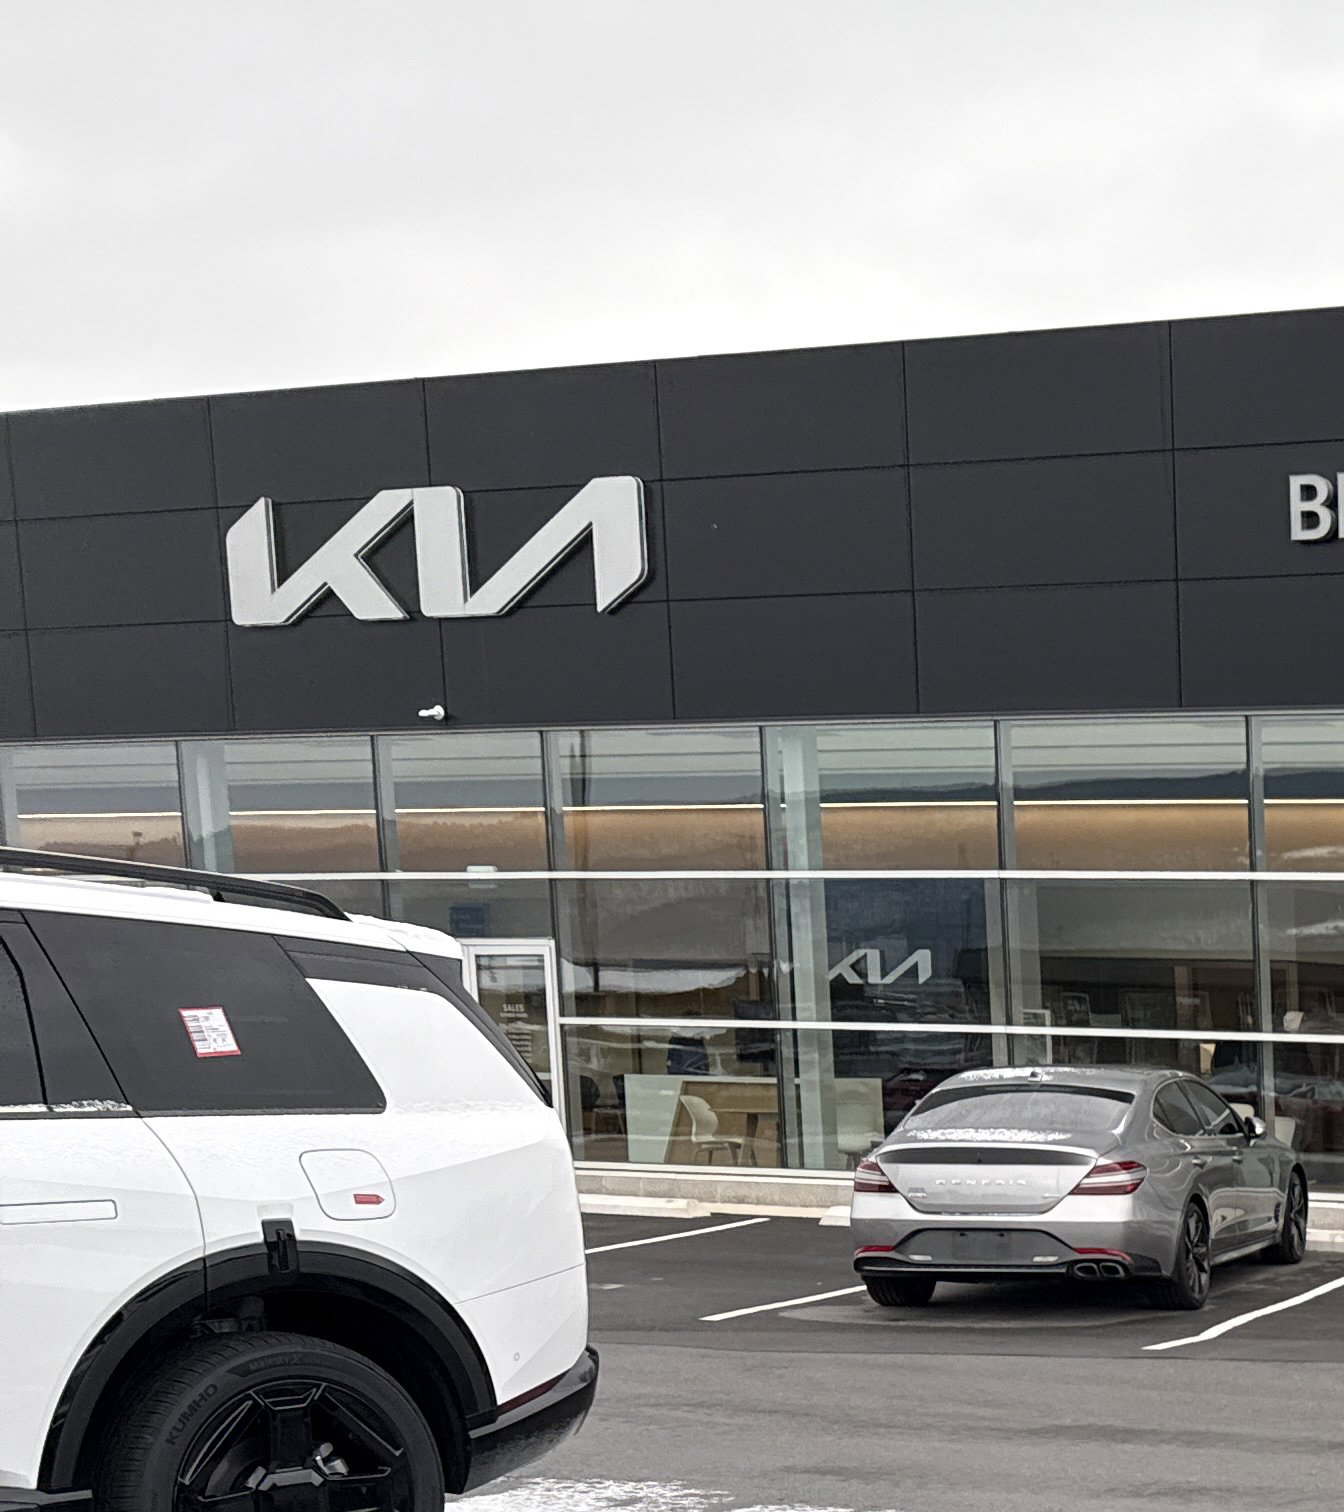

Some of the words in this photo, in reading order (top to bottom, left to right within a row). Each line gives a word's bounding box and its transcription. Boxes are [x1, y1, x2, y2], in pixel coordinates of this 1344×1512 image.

[226, 475, 648, 627] KIA
[502, 1003, 525, 1012] SALES
[165, 1383, 218, 1445] KUMHO
